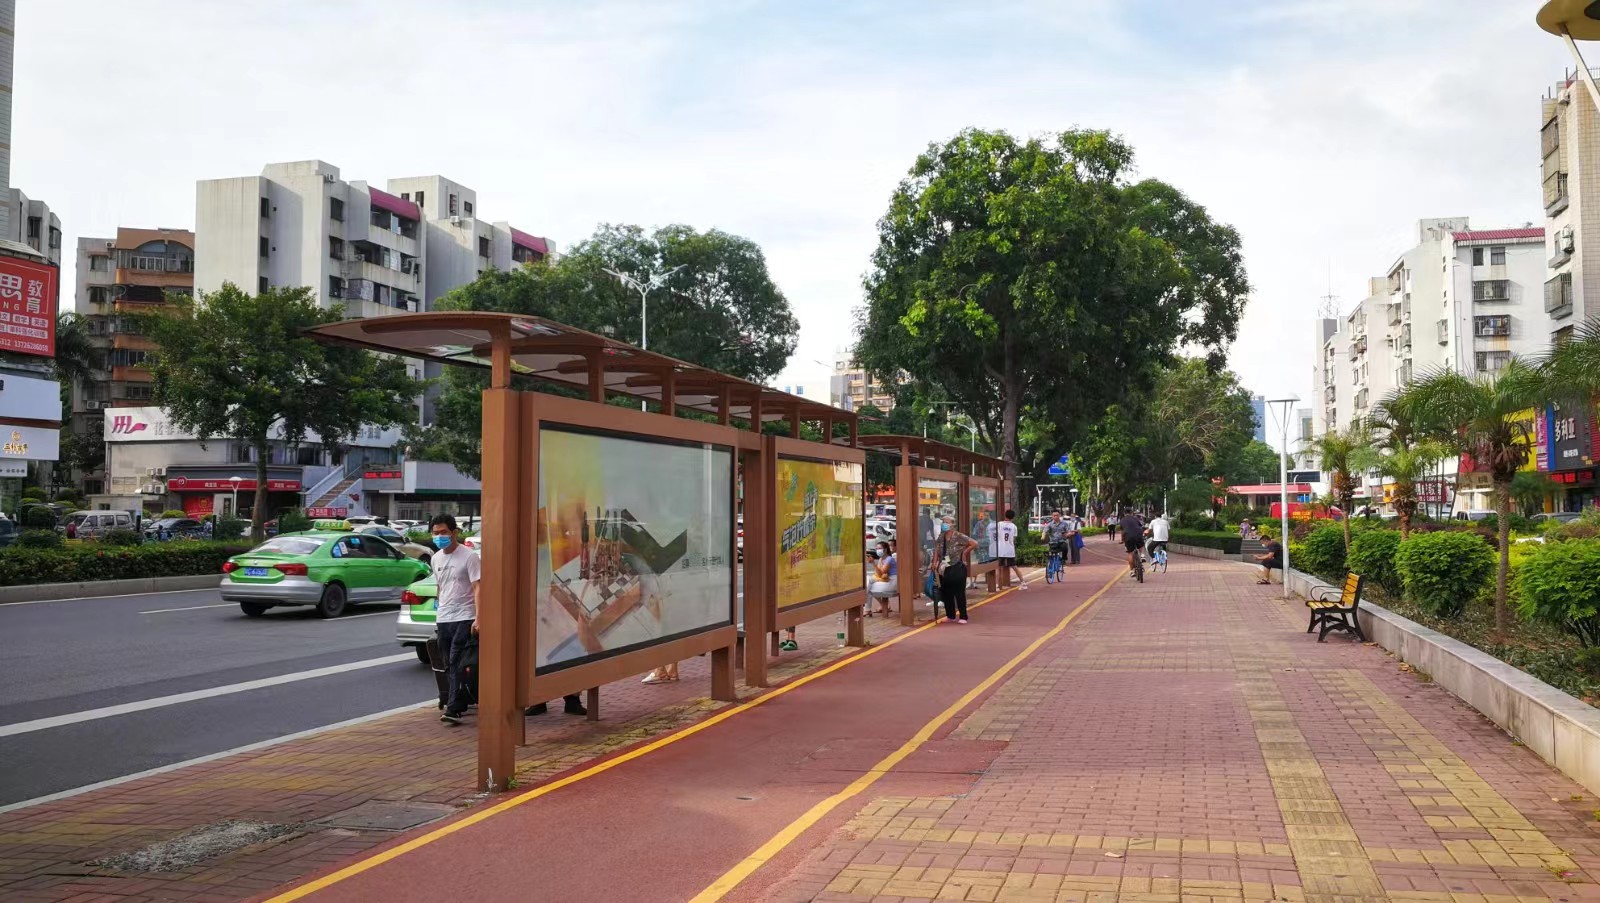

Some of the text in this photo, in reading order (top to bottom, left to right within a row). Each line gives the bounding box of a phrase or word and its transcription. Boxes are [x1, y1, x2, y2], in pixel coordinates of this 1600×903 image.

[27, 279, 43, 314] 教育
[319, 521, 341, 529] TAXI
[1004, 533, 1010, 542] 8
